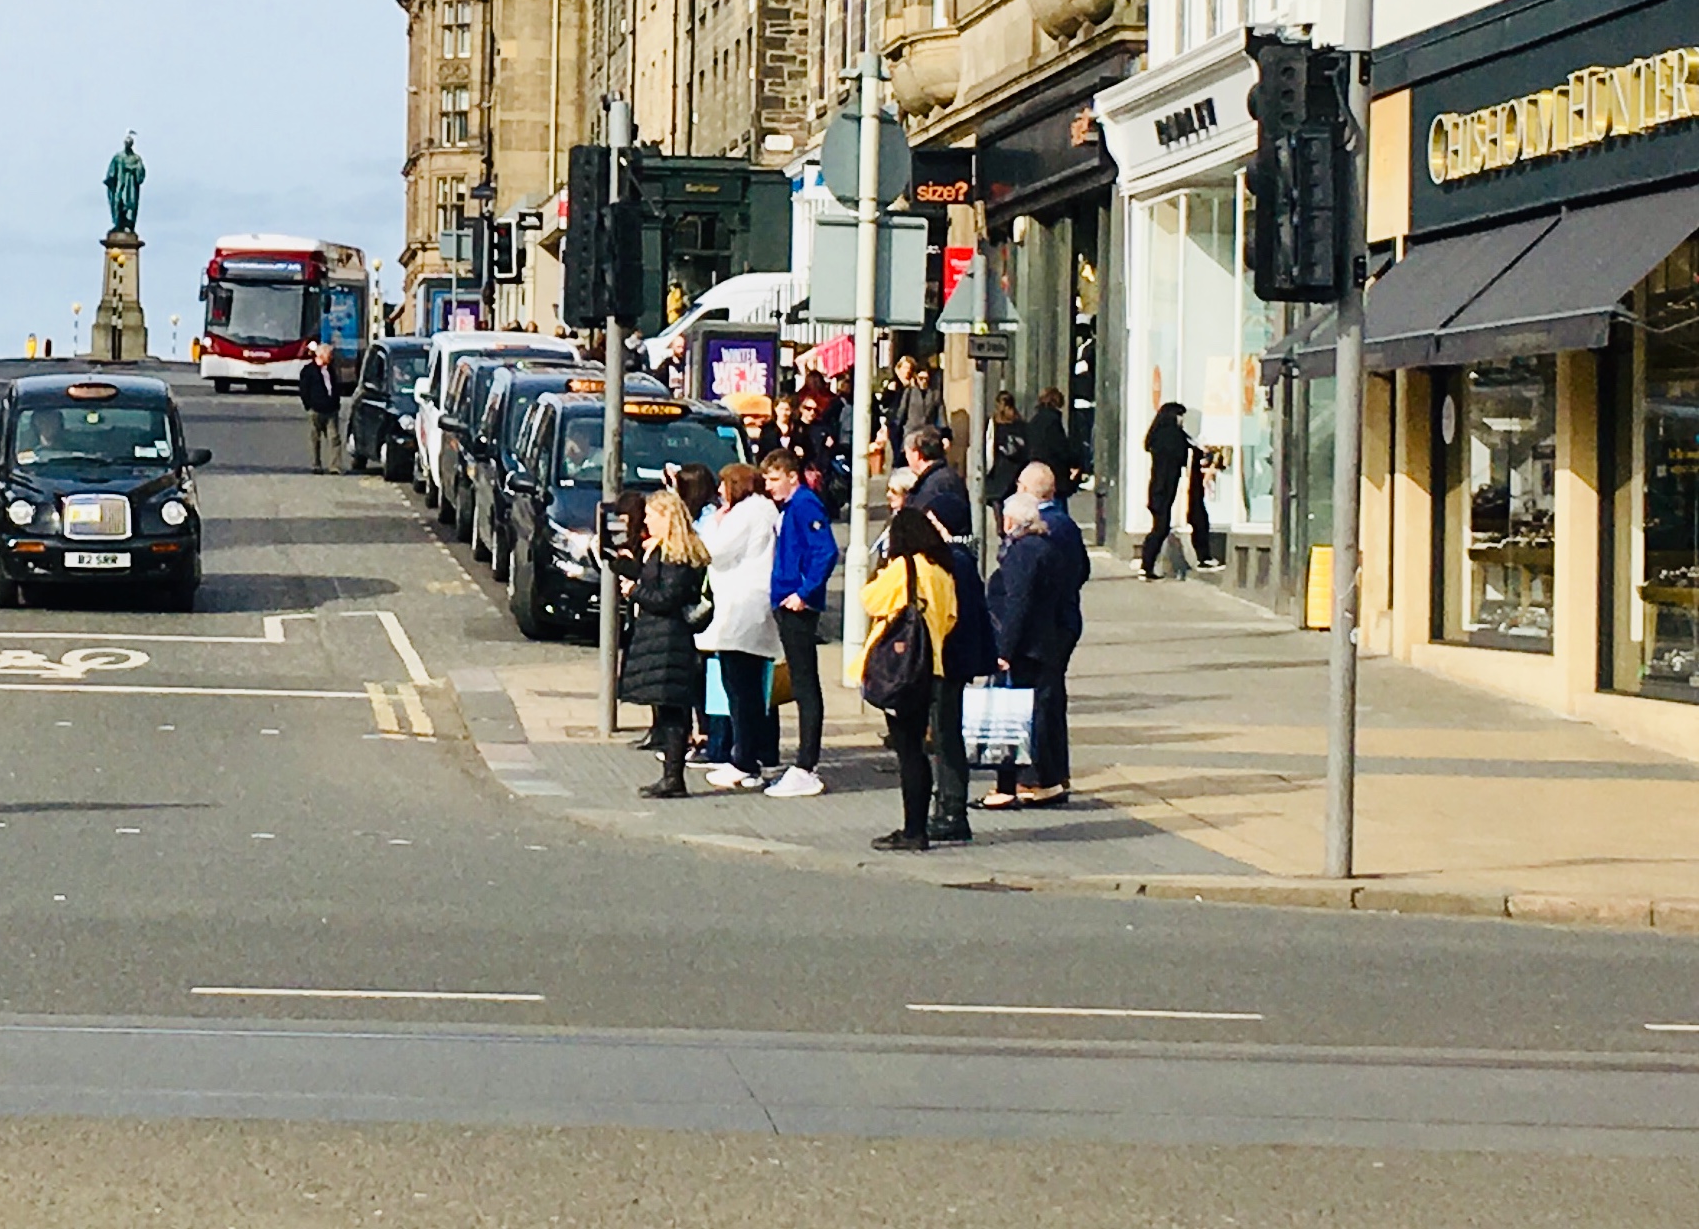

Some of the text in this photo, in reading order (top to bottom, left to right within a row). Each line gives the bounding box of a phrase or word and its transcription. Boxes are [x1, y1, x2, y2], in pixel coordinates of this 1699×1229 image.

[1428, 49, 1694, 184] CHISHOLM HUNTER
[916, 180, 969, 202] size?
